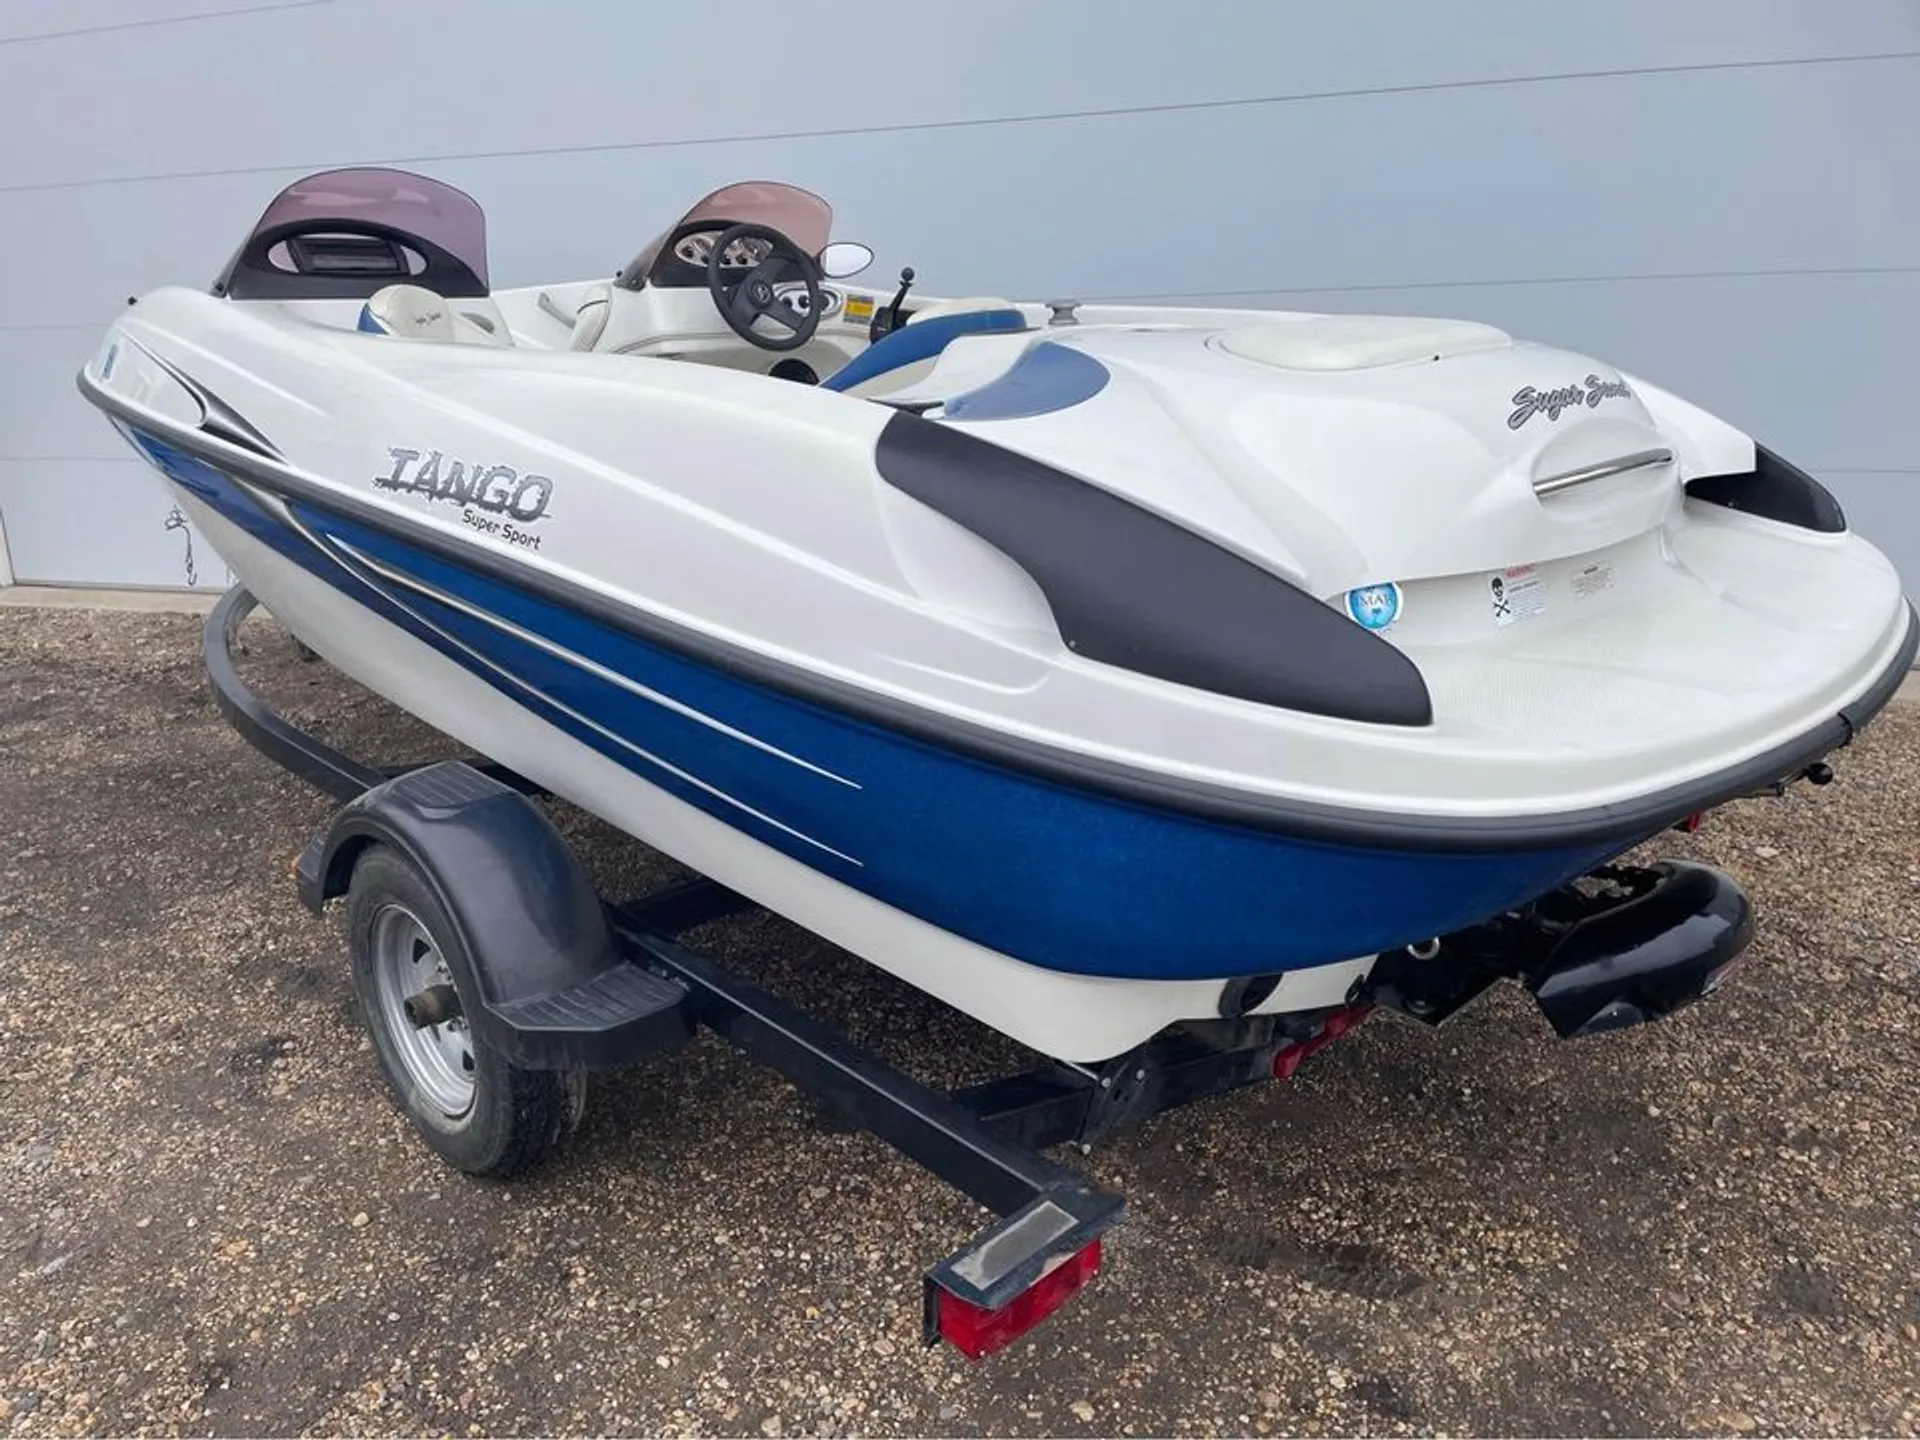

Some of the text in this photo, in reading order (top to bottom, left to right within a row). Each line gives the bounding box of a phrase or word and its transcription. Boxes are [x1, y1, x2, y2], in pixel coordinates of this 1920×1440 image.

[1508, 385, 1585, 430] Sugar
[372, 448, 553, 521] TANGO
[463, 509, 541, 550] Super Sport
